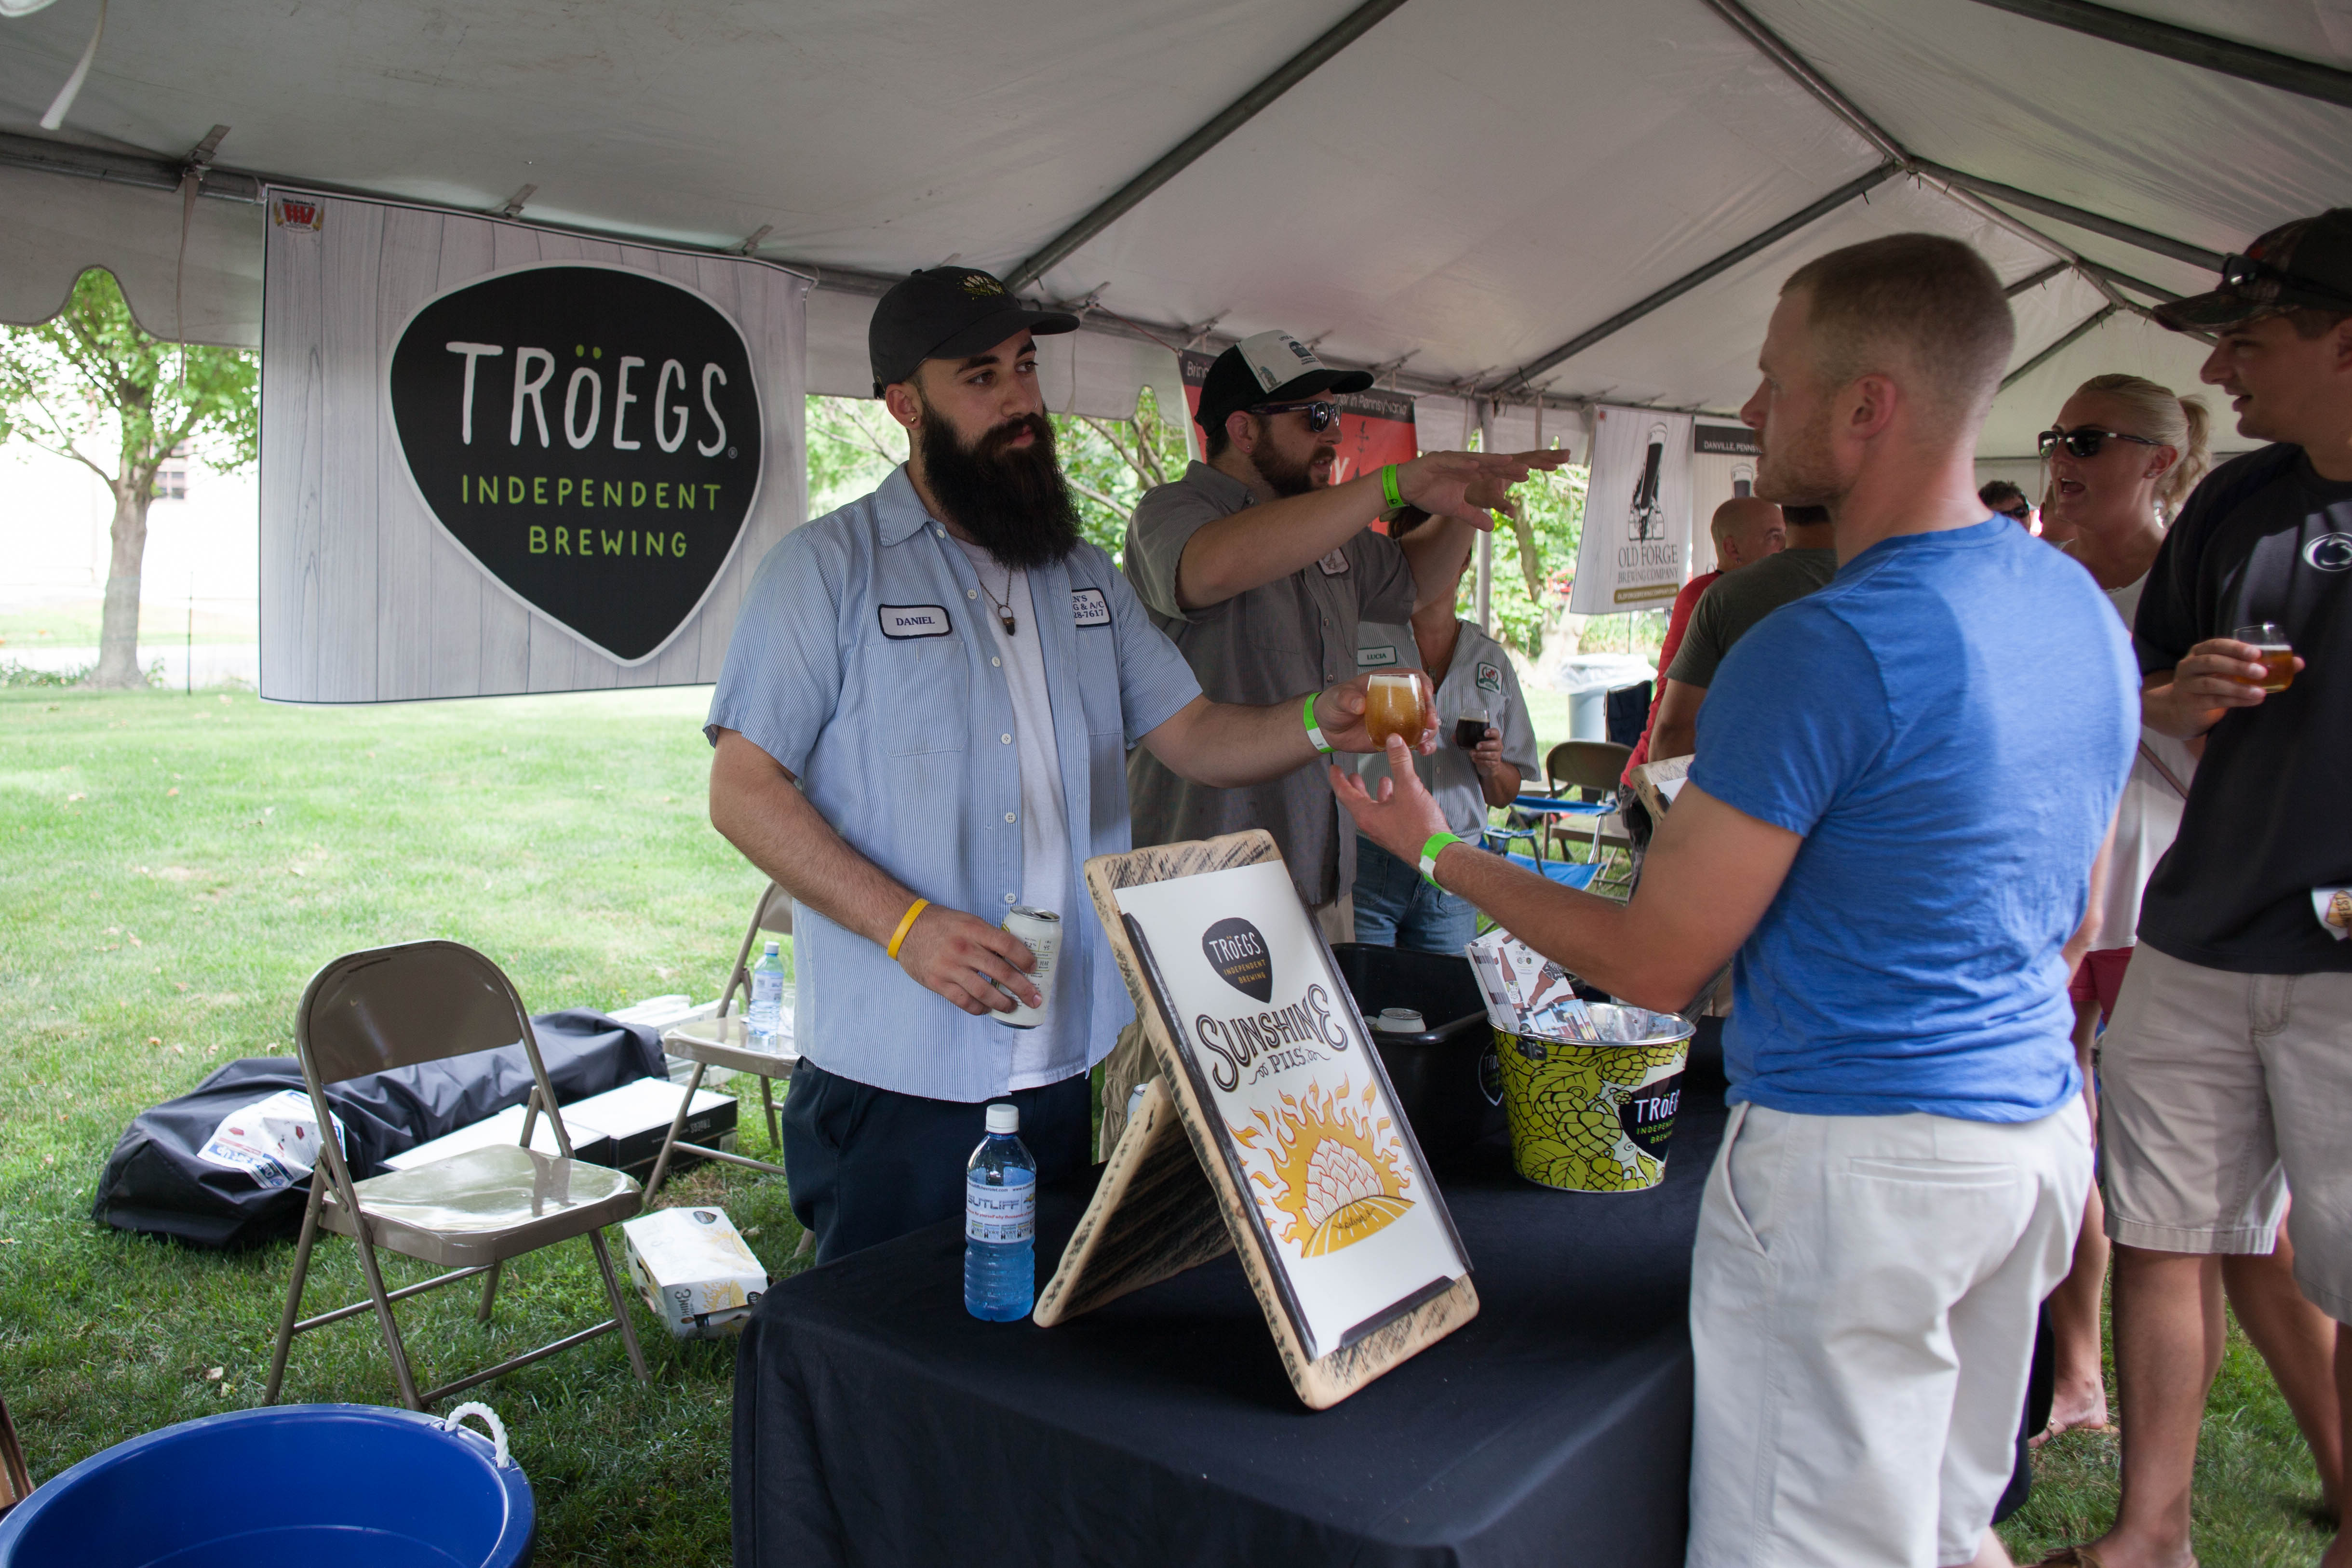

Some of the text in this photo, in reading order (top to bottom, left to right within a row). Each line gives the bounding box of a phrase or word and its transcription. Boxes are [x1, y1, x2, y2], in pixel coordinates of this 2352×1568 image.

[445, 341, 727, 457] TRÖEGS
[462, 474, 721, 510] INDEPENDENT
[530, 526, 687, 558] BREWING
[1618, 543, 1678, 568] OLD FORGE
[1618, 566, 1679, 584] BREWING COMPANY
[1089, 601, 1104, 609] A/C
[896, 616, 935, 626] DANIEL
[1209, 931, 1261, 964] TRÖEGS
[1223, 959, 1266, 976] INDEPENDENT
[1238, 971, 1266, 984] BREWING
[1196, 983, 1348, 1093] SUNSHINE
[968, 1193, 1019, 1210] SUTLIFF
